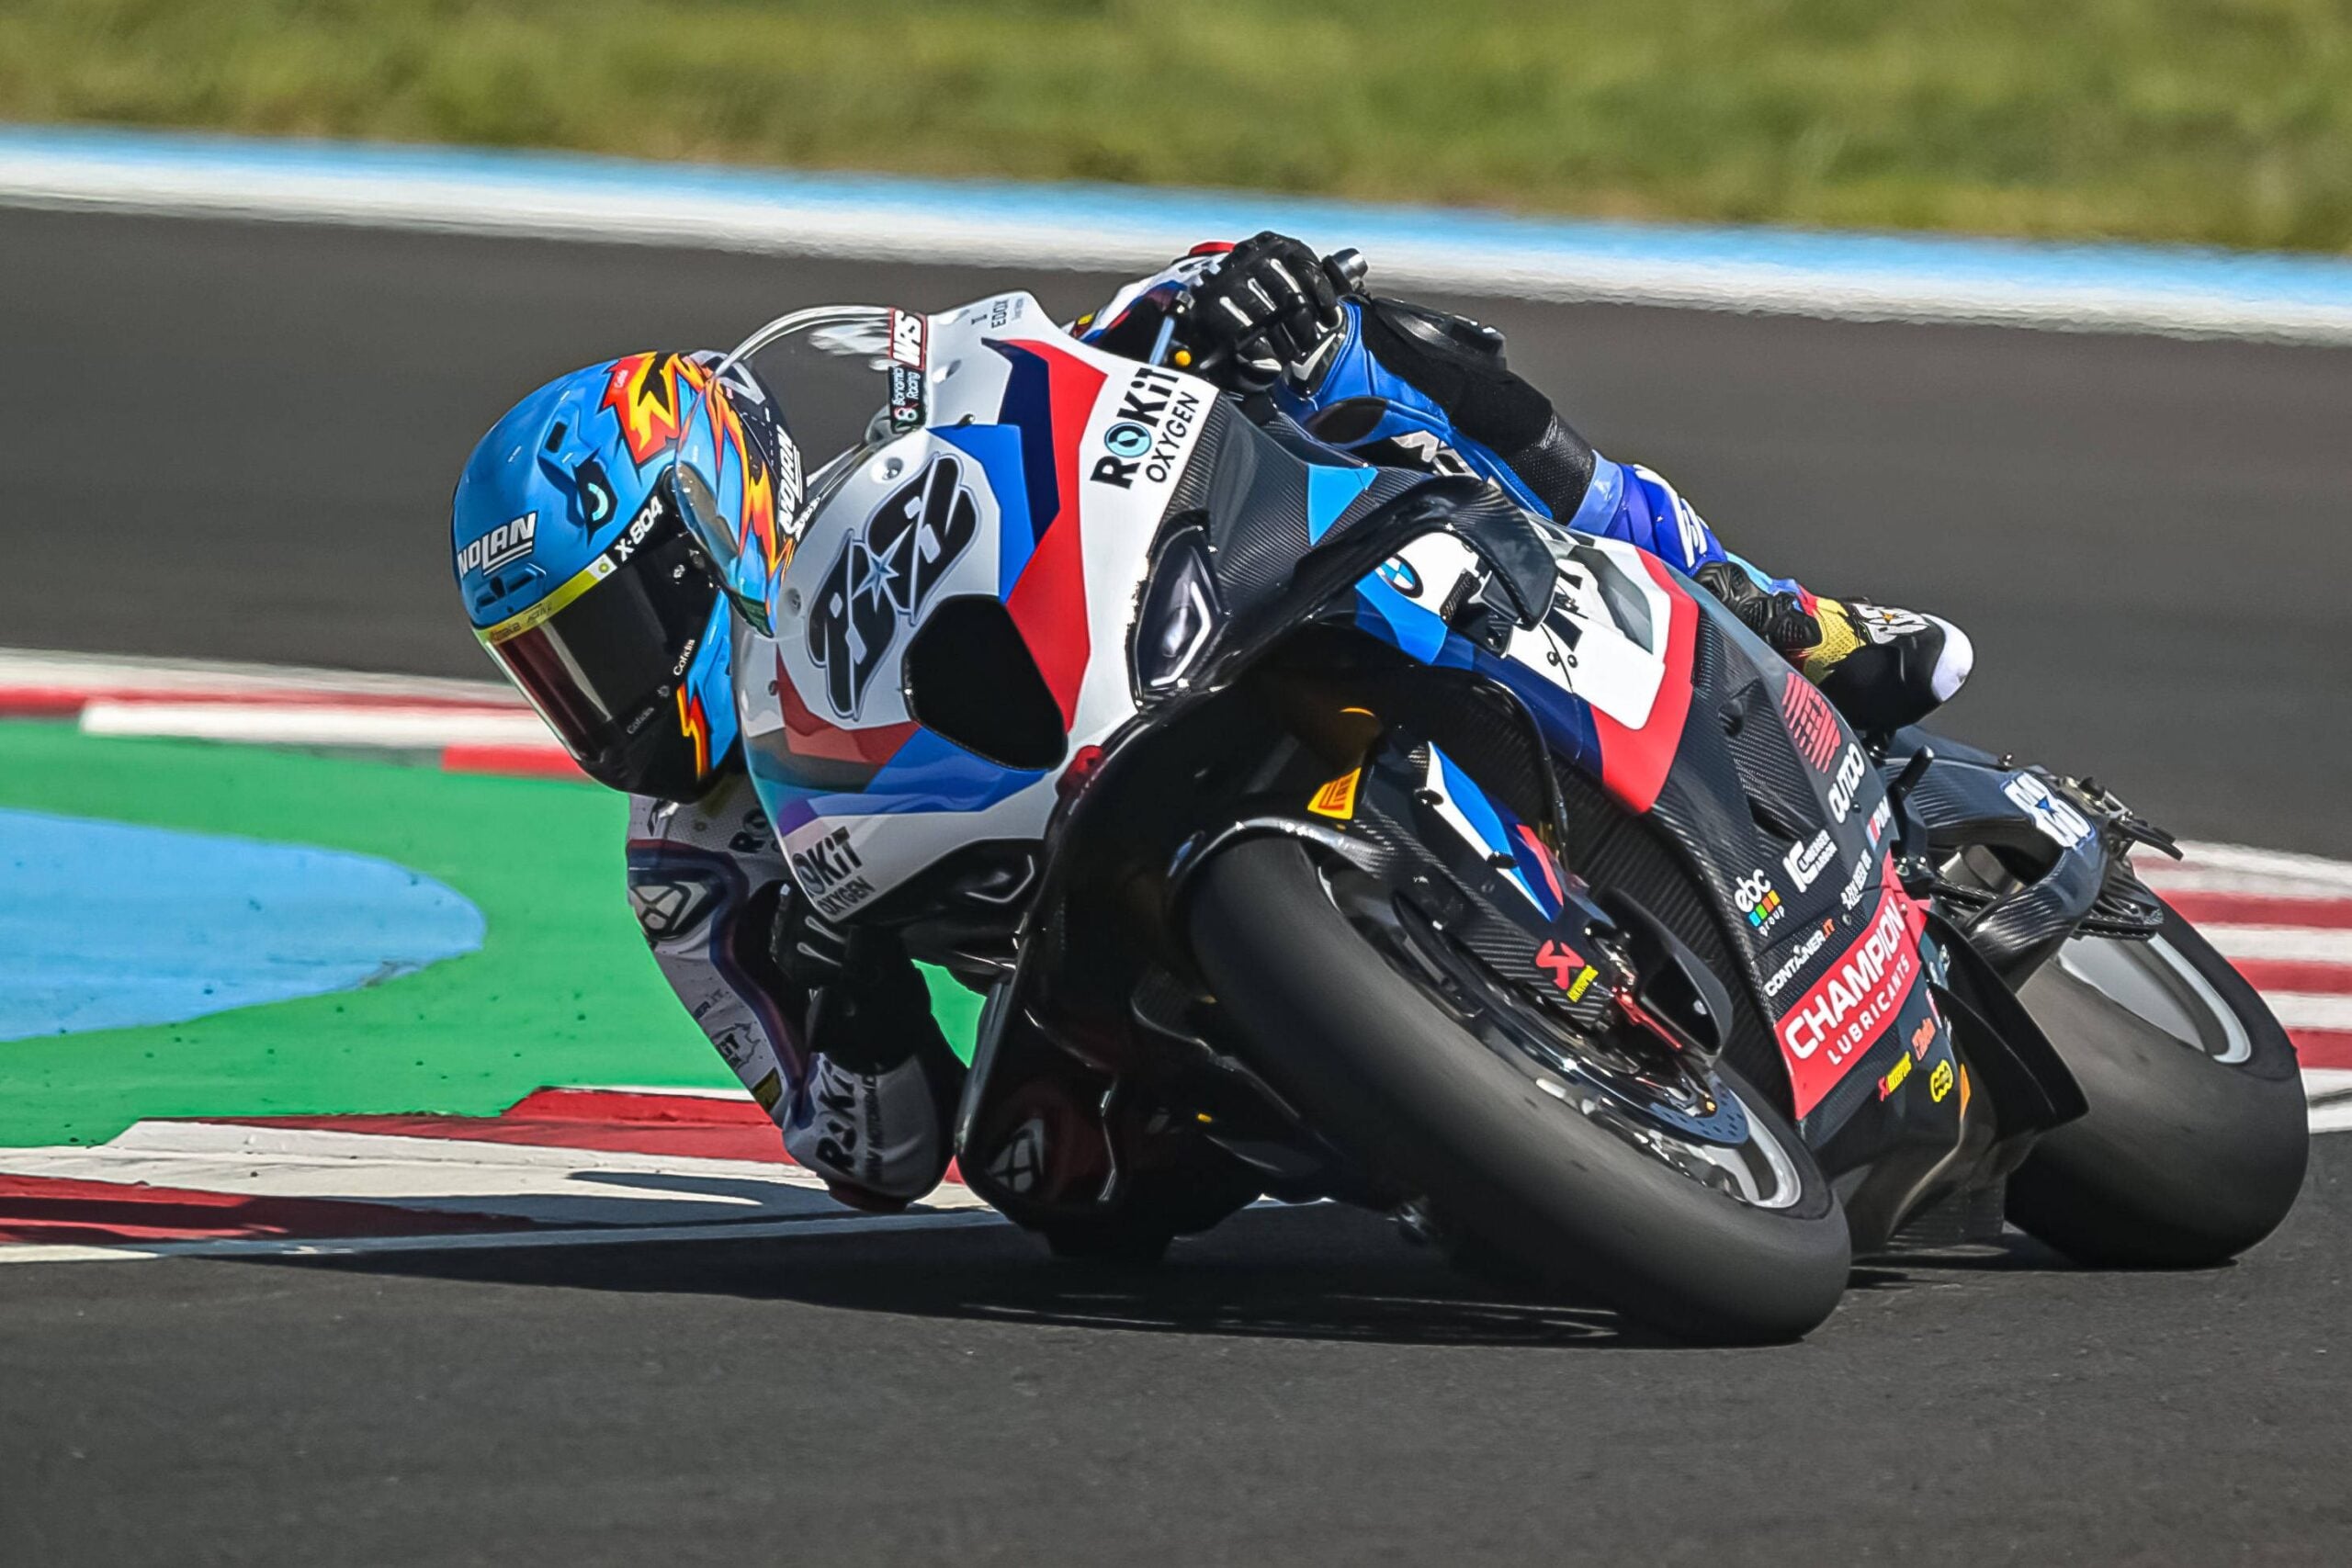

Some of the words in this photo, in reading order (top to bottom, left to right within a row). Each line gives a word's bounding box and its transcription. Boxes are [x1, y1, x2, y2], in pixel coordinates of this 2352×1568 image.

[1146, 392, 1200, 484] OXYGEN
[458, 512, 537, 576] NOLAN
[615, 496, 662, 561] X-804
[1827, 742, 1865, 824] OUTDO
[792, 826, 863, 897] OKiT
[1734, 868, 1771, 913] ebc
[1758, 905, 1785, 937] group
[1784, 897, 1905, 1059] CHAMPION
[1826, 953, 1910, 1065] LUBRICANTS
